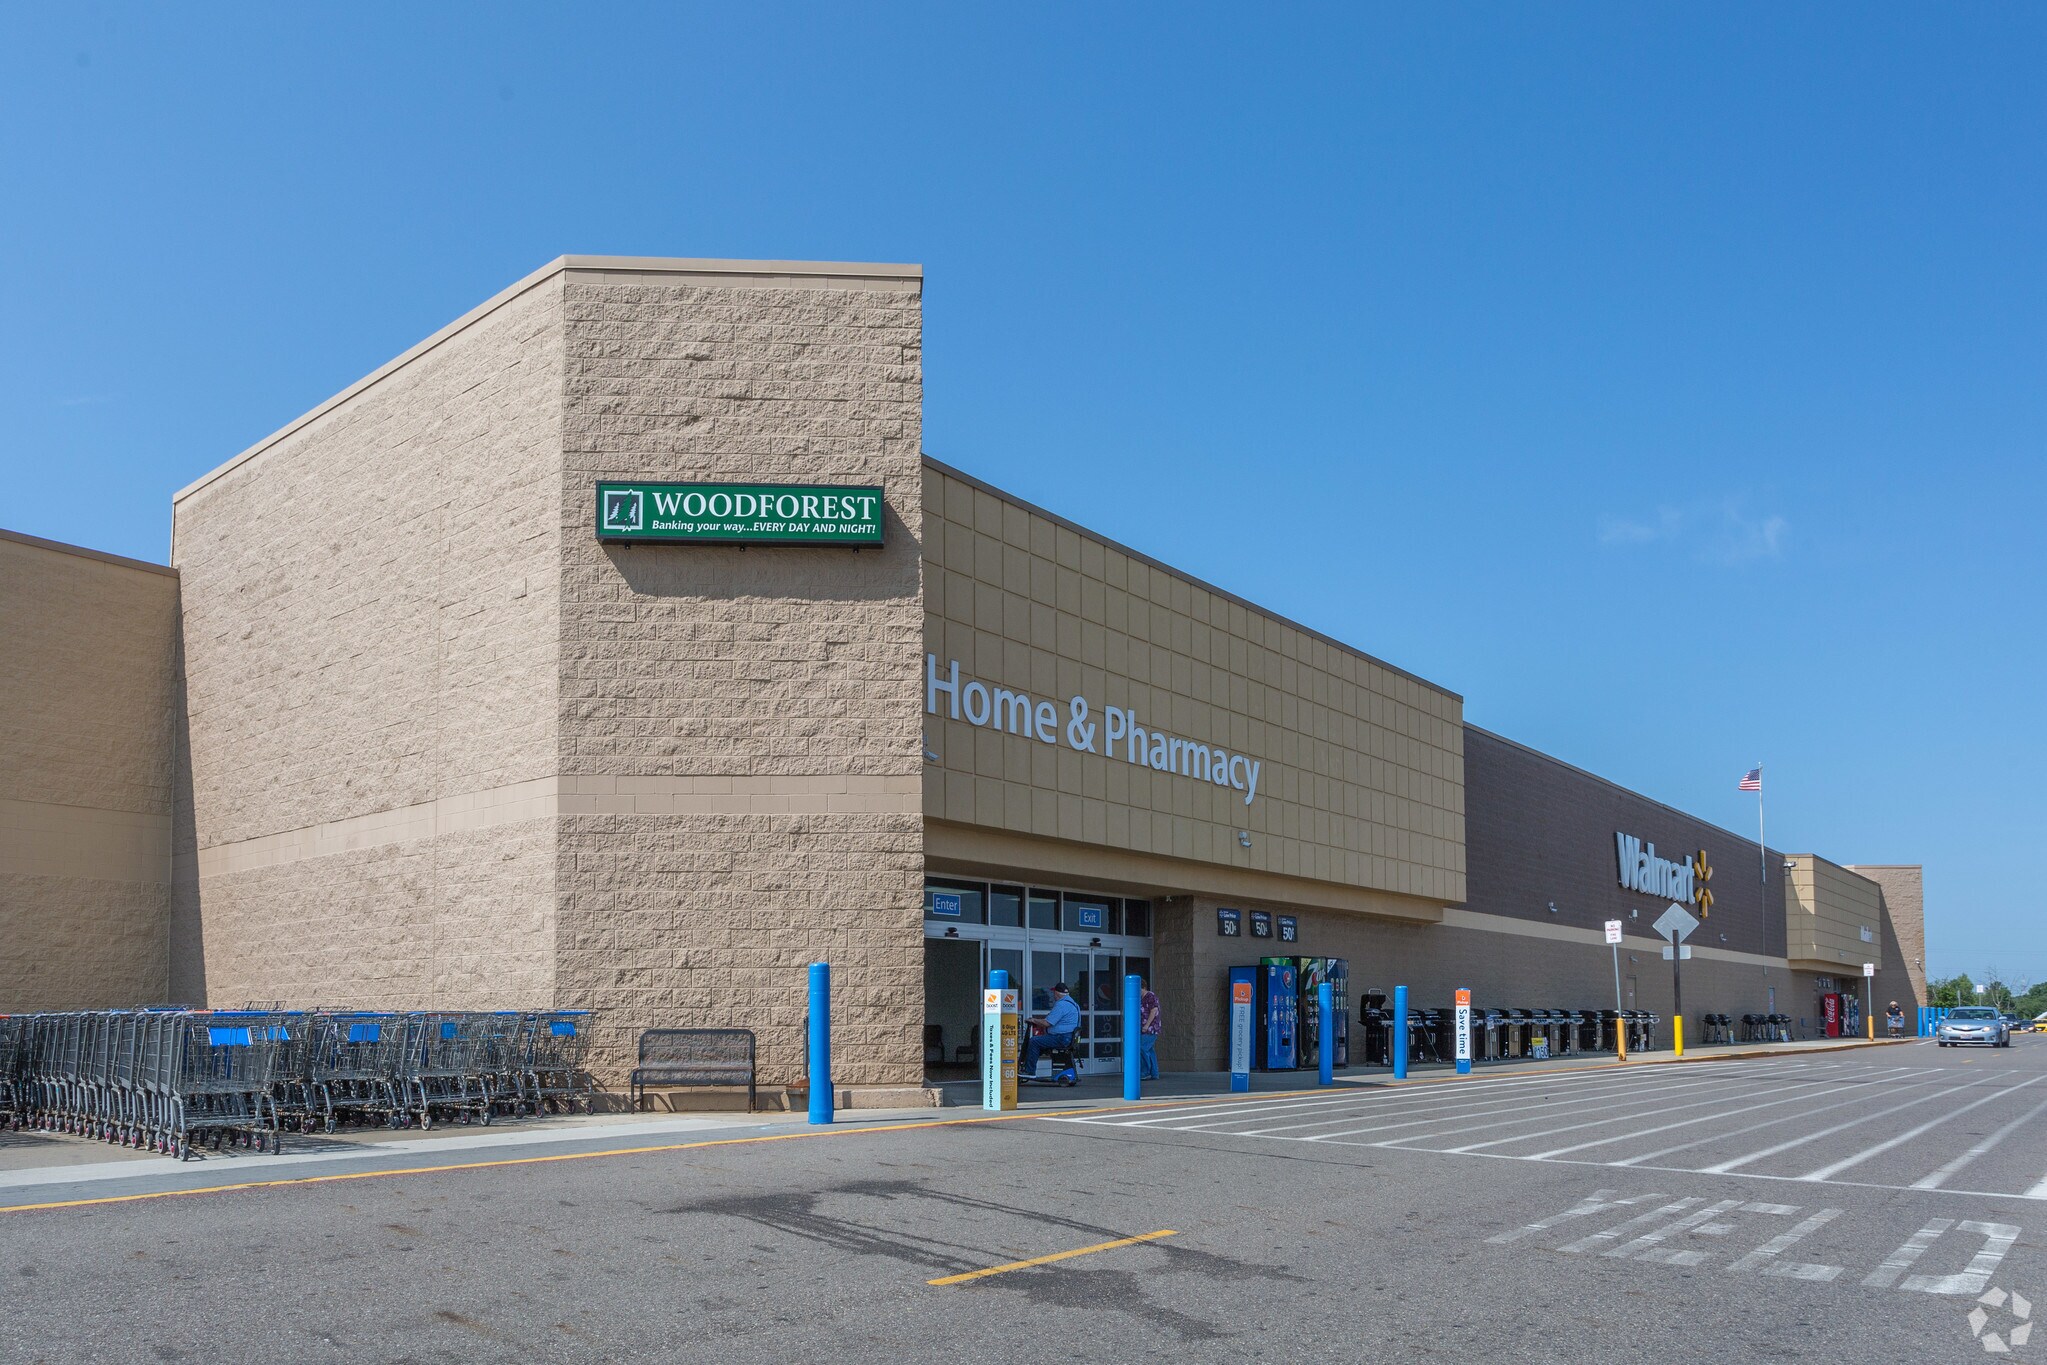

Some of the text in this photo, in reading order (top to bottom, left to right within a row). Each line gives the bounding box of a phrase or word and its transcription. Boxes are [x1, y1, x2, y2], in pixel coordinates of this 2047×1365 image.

[652, 492, 876, 520] WOODFOREST
[652, 520, 694, 532] Banking
[696, 522, 721, 533] your
[788, 522, 810, 533] DAY
[812, 523, 836, 533] AND
[839, 523, 876, 534] NIGHT!
[927, 653, 1261, 806] Home & Pharmacy
[1616, 831, 1696, 905] Walmart
[935, 897, 958, 911] Enter
[1083, 912, 1097, 924] Exit
[1458, 1008, 1468, 1031] Save
[1458, 1033, 1468, 1055] time
[1483, 1189, 2023, 1296] YIELD
